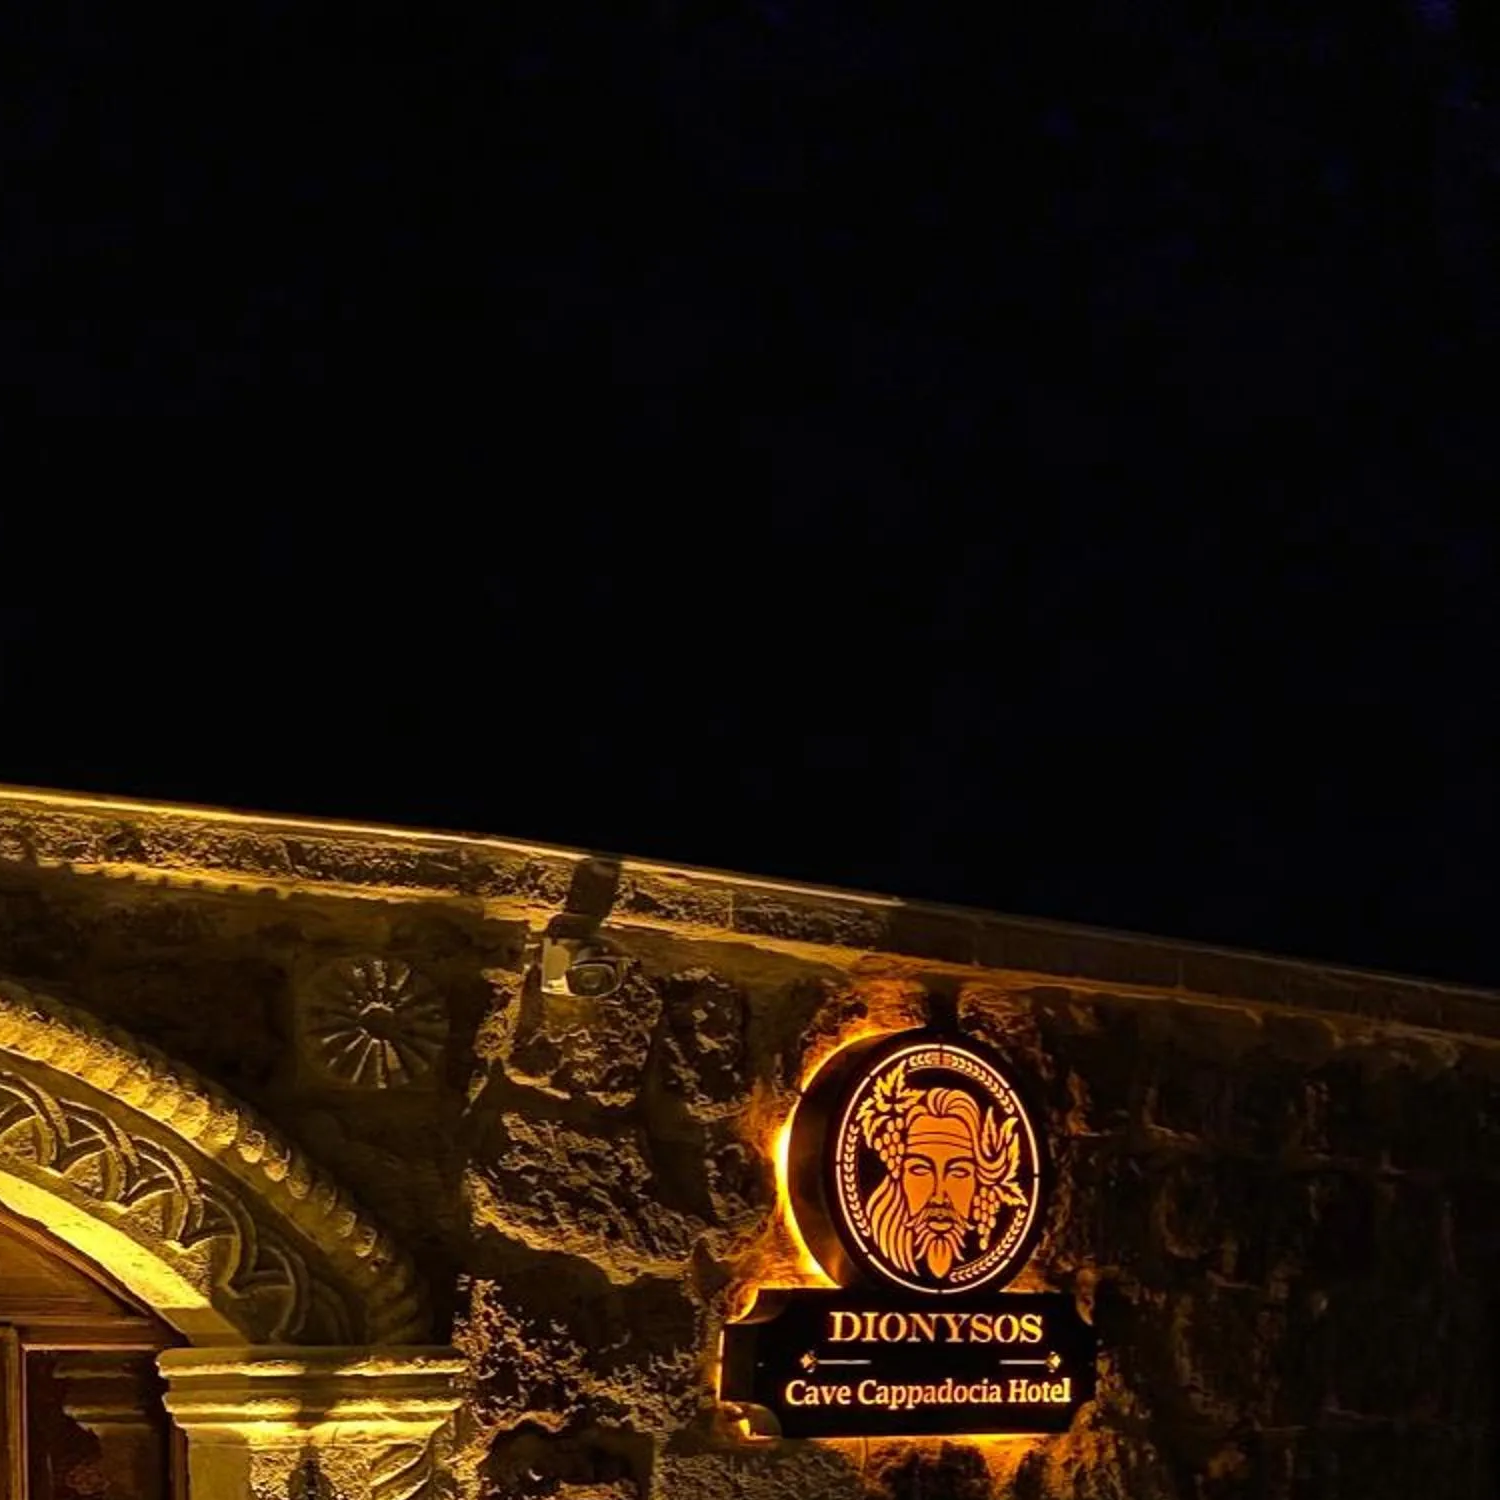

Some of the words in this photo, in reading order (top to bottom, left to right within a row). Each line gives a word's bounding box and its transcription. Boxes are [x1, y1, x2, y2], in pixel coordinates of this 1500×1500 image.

[828, 1311, 1044, 1343] DIONYSOS
[785, 1379, 851, 1406] Cave
[857, 1378, 1002, 1410] Cappadocia
[1007, 1377, 1071, 1404] Hotel
